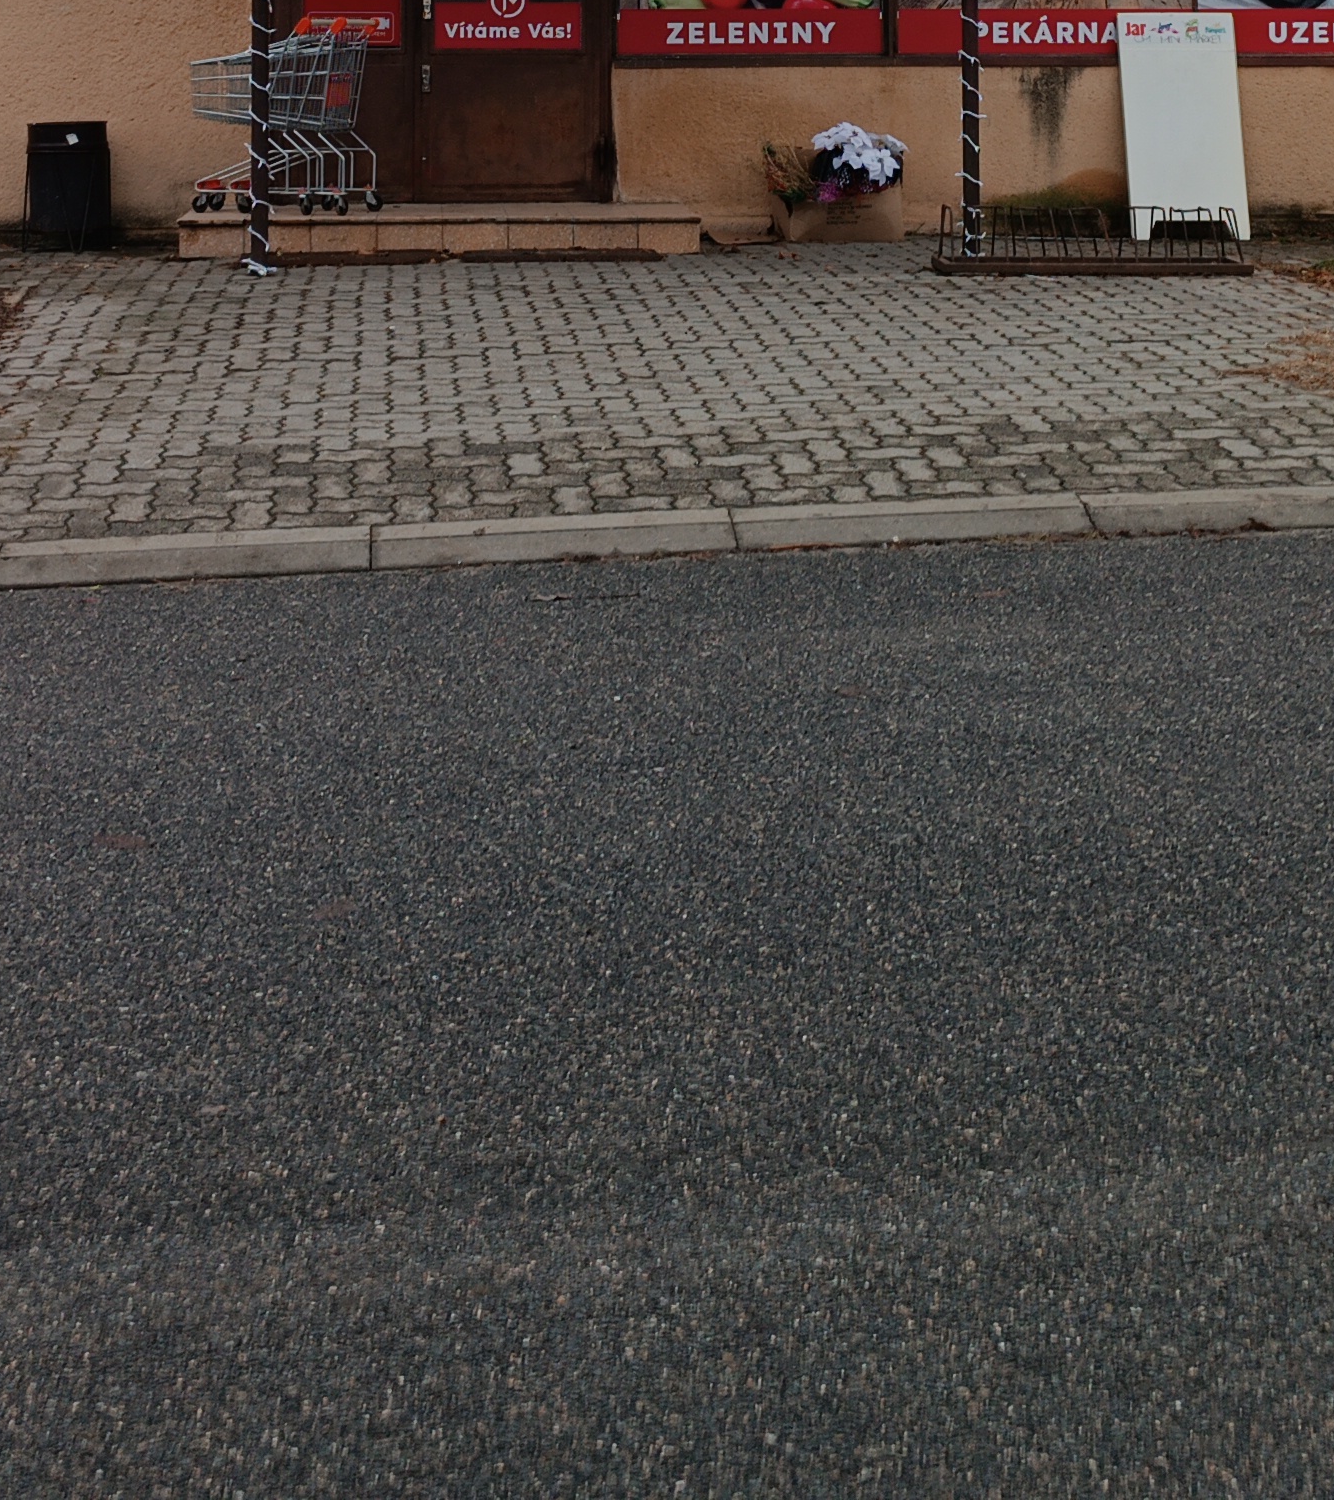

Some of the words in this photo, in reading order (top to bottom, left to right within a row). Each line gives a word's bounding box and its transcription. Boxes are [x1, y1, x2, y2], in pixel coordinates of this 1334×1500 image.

[444, 22, 520, 39] Vítáme
[529, 22, 572, 39] Vás!
[666, 22, 836, 44] ZELENINY
[1125, 22, 1146, 36] Jar
